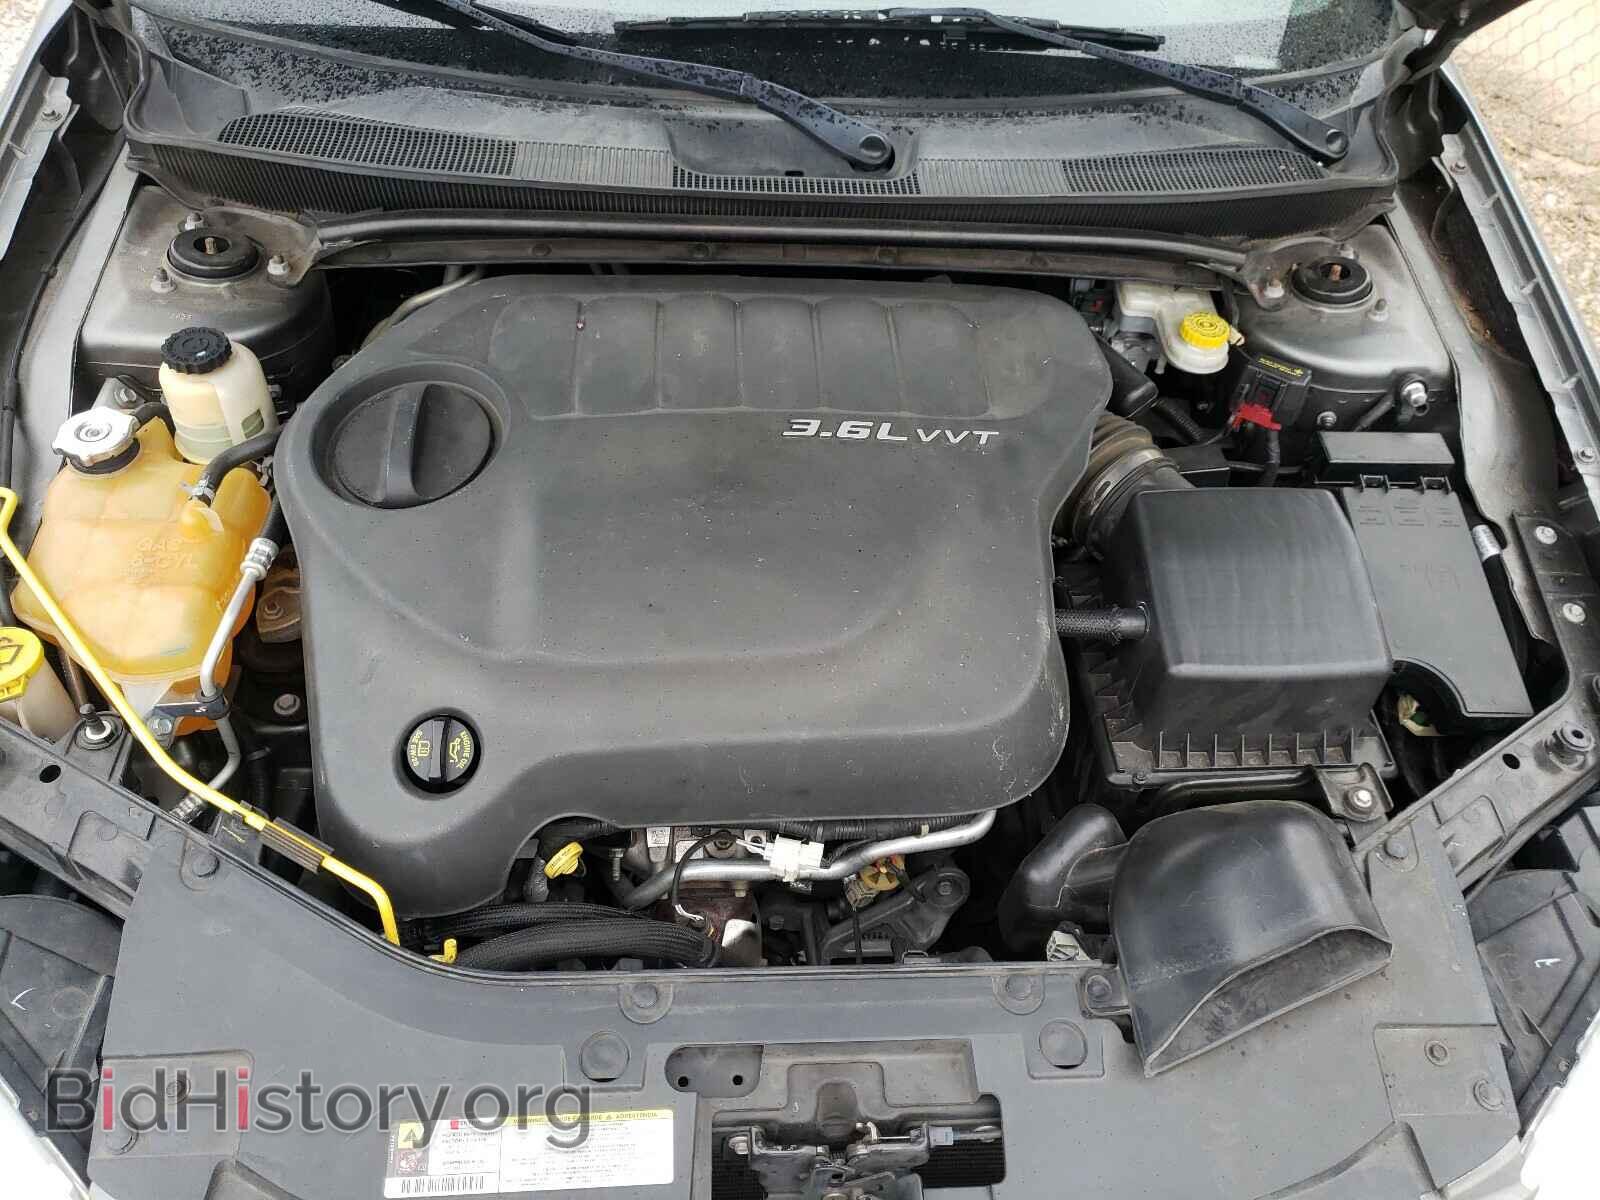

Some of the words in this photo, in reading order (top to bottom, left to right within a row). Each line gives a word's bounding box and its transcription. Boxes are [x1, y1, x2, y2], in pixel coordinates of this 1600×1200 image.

[782, 418, 908, 441] 3.6L
[916, 428, 999, 445] VVT
[460, 731, 471, 757] ENGINE
[456, 759, 469, 769] OIL
